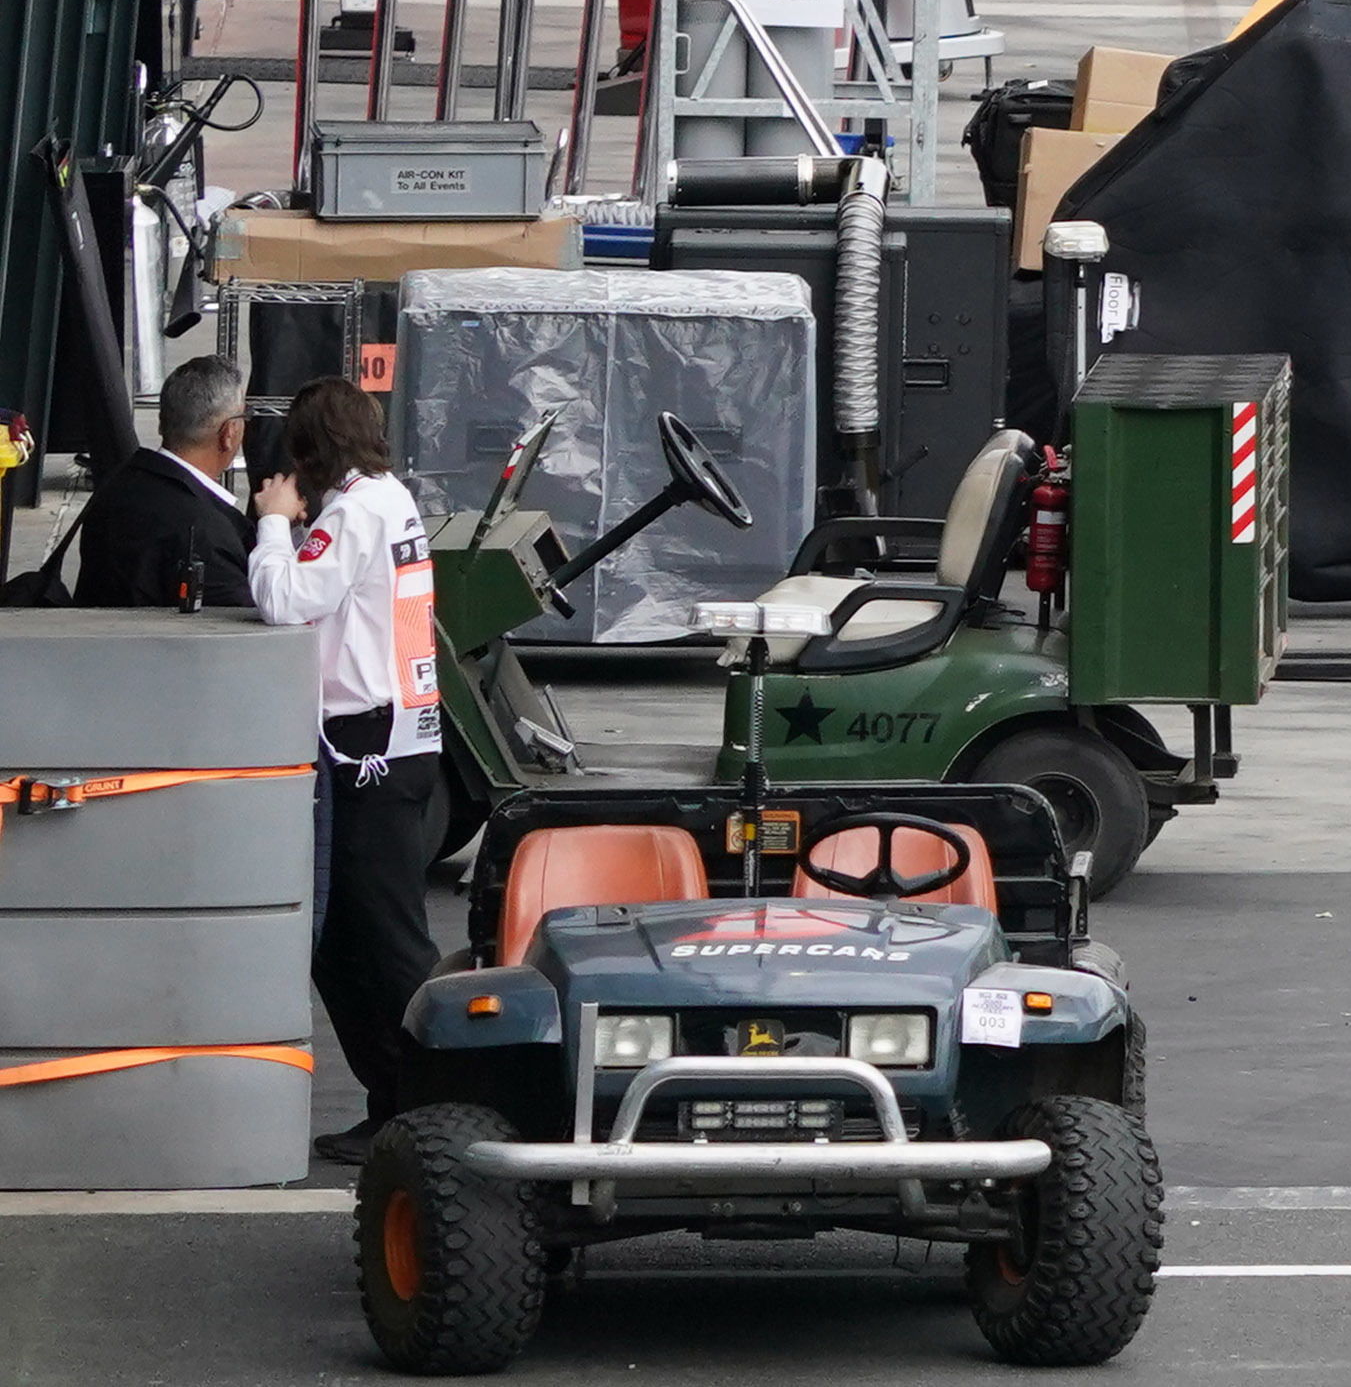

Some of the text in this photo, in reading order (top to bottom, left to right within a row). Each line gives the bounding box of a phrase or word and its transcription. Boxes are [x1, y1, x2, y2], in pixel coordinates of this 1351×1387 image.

[397, 170, 466, 179] AIR-CON KIT
[397, 181, 466, 190] To All Events
[1108, 275, 1123, 317] Floor
[846, 712, 942, 744] 4077
[85, 779, 121, 794] GRUNT
[670, 942, 911, 962] SUPERCARS
[979, 1016, 1006, 1029] 003
